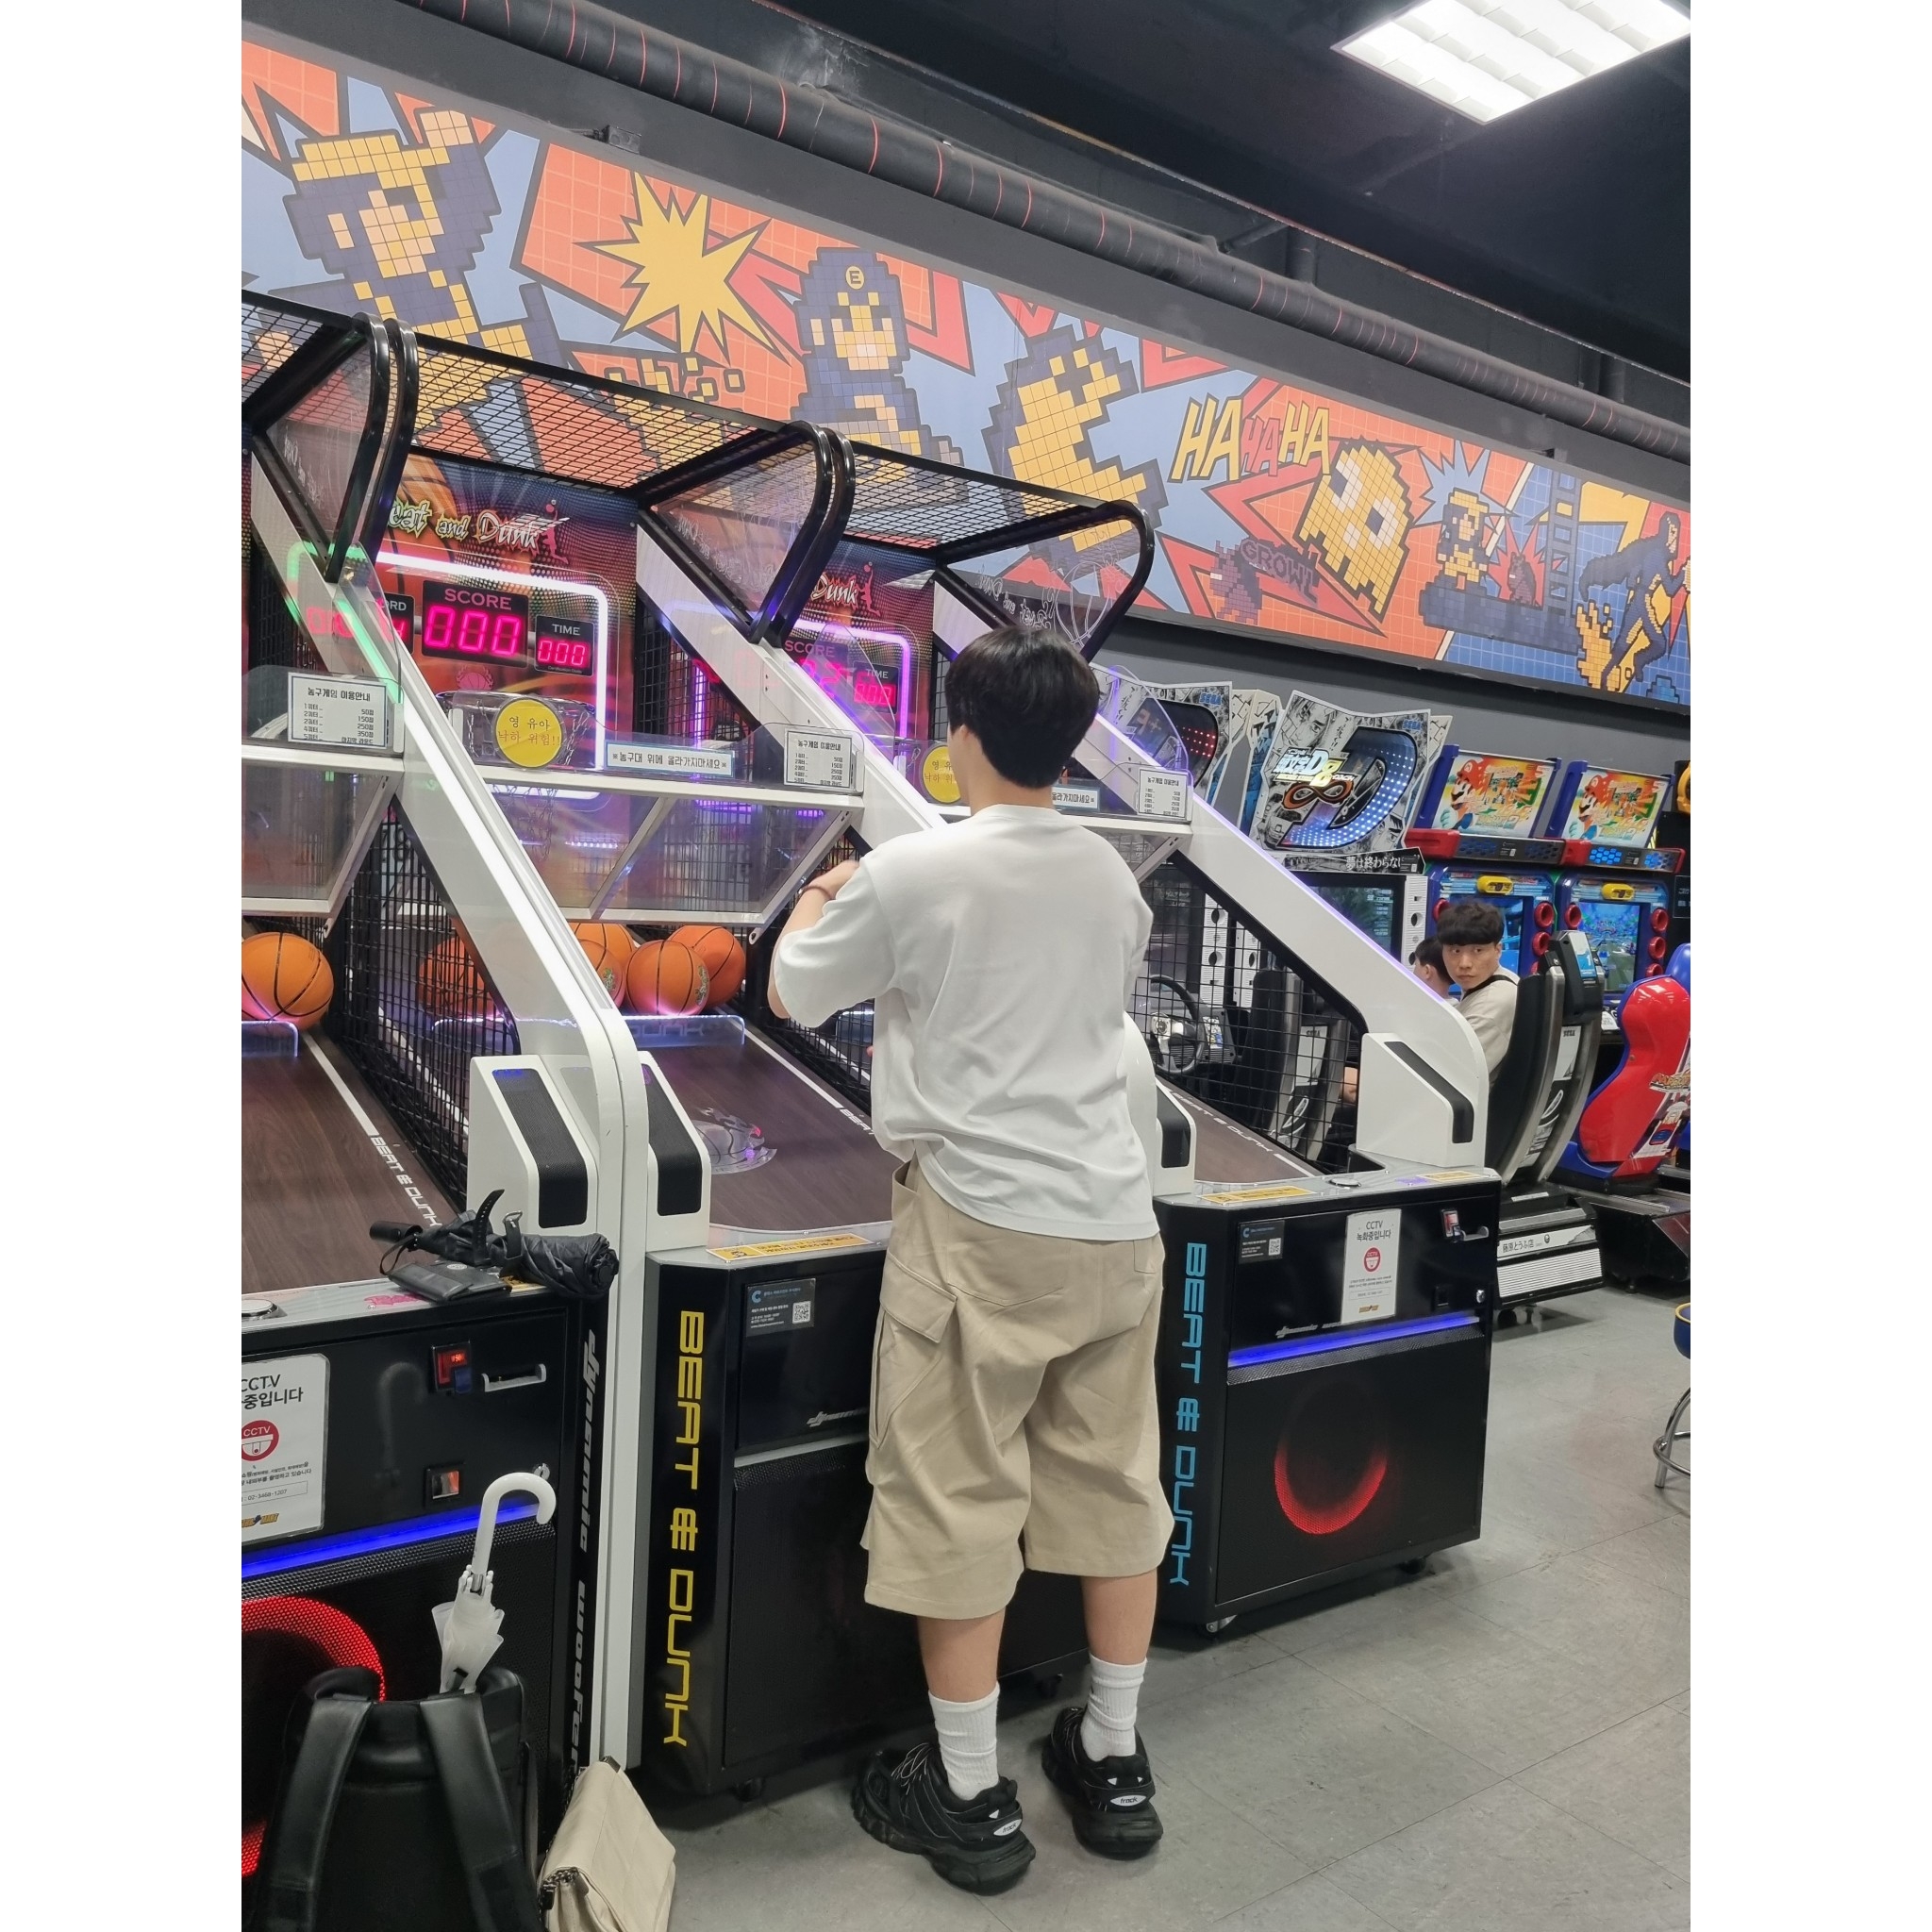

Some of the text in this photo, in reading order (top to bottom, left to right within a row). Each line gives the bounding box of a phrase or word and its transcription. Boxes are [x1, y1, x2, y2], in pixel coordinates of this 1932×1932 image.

[1168, 393, 1241, 482] HA
[1241, 415, 1280, 476] HA
[1276, 400, 1331, 475] HA
[436, 514, 471, 541] and
[475, 510, 539, 554] Dunk
[1240, 538, 1318, 606] GROWL
[444, 589, 512, 610] SCORE
[425, 605, 522, 657] 000
[552, 624, 581, 636] TIME
[538, 640, 586, 666] 000
[784, 640, 836, 658] SCORE
[866, 669, 889, 679] TIME
[308, 687, 371, 702] 농구게임 이용안내
[498, 730, 521, 743] 낙하
[509, 715, 551, 732] 영 유아
[647, 755, 663, 765] 위에
[840, 1108, 874, 1135] BEA
[370, 1137, 405, 1172] BEAT
[405, 1187, 442, 1226] DUNK
[1357, 1229, 1391, 1241] 녹화중입니다
[1366, 1220, 1383, 1230] CCTV
[1180, 1242, 1208, 1384] BEAT
[242, 1387, 304, 1410] 중입니다
[674, 1310, 705, 1490] BEAT
[243, 1425, 272, 1437] CCTV
[579, 1328, 600, 1554] dynamic
[1169, 1445, 1197, 1586] DUNK
[663, 1569, 694, 1748] DUNK
